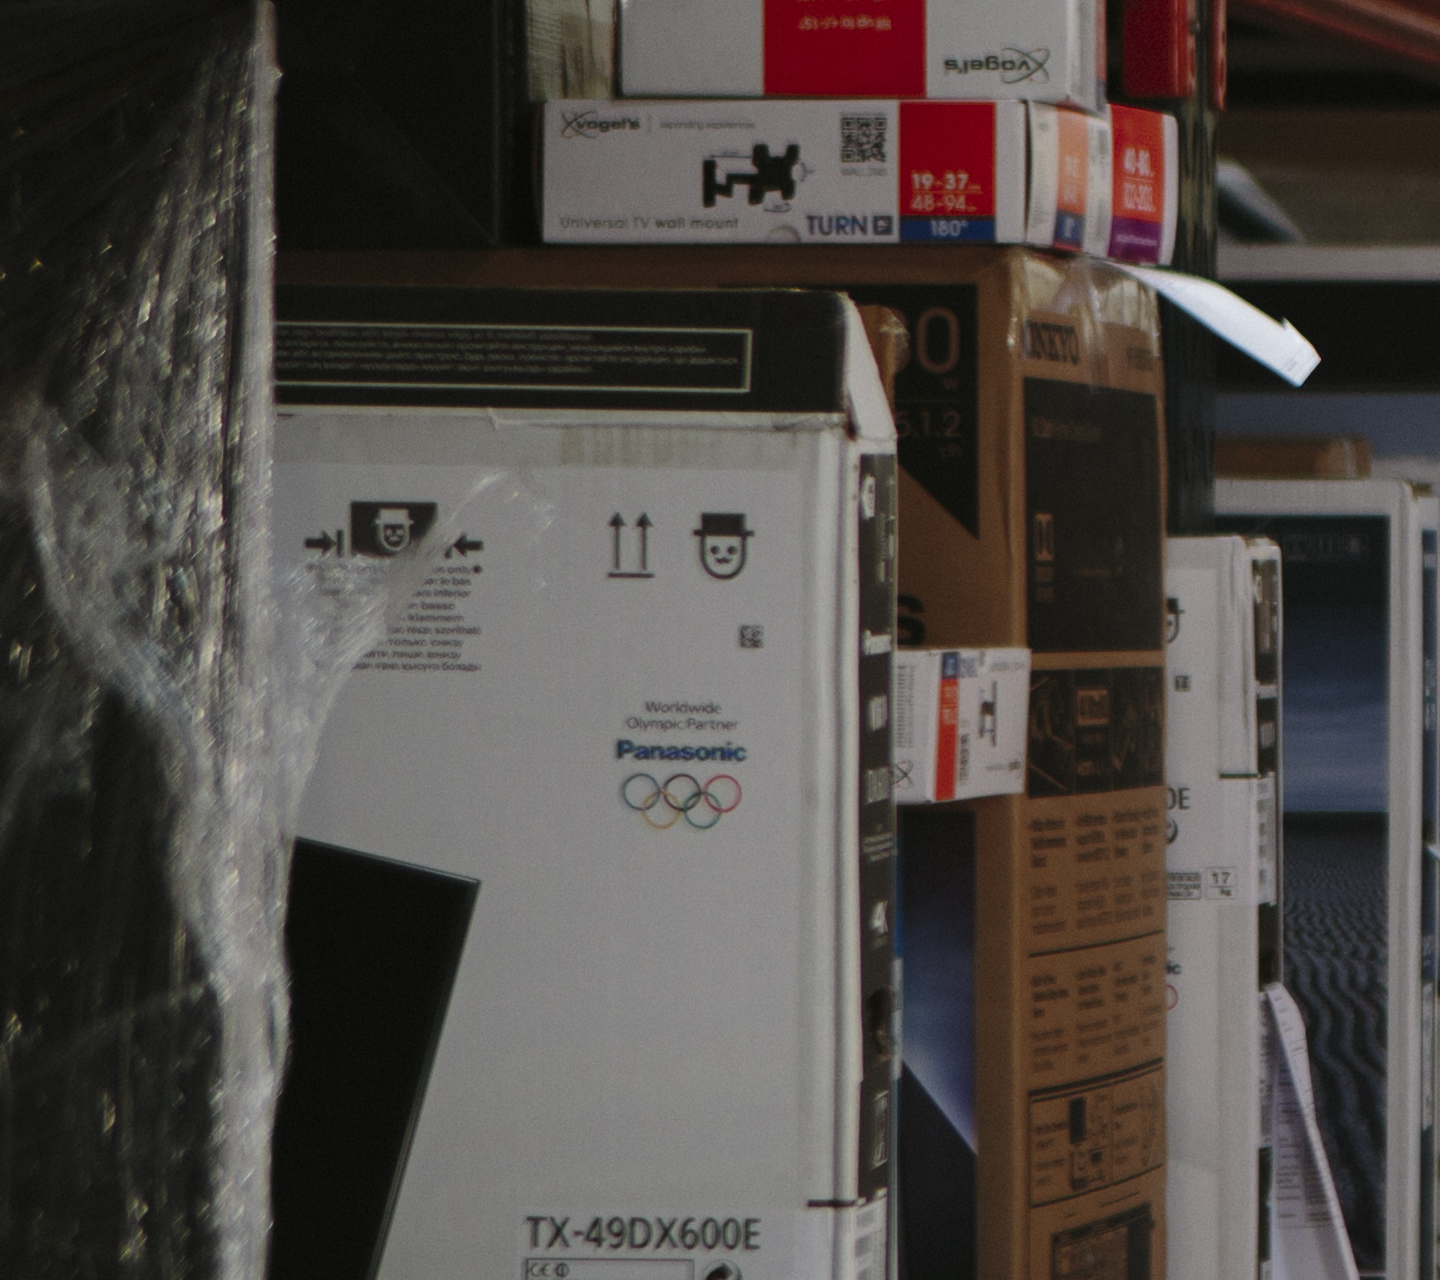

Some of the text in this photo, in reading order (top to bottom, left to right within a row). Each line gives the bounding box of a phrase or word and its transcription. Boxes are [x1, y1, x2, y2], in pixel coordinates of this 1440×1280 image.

[559, 216, 739, 230] Universal TV wall mount
[806, 215, 868, 236] TURN
[645, 700, 722, 714] Worldwide
[625, 716, 739, 732] Olympic Partner
[616, 738, 748, 762] Panasonic
[526, 1216, 761, 1250] TX-49DX600E
